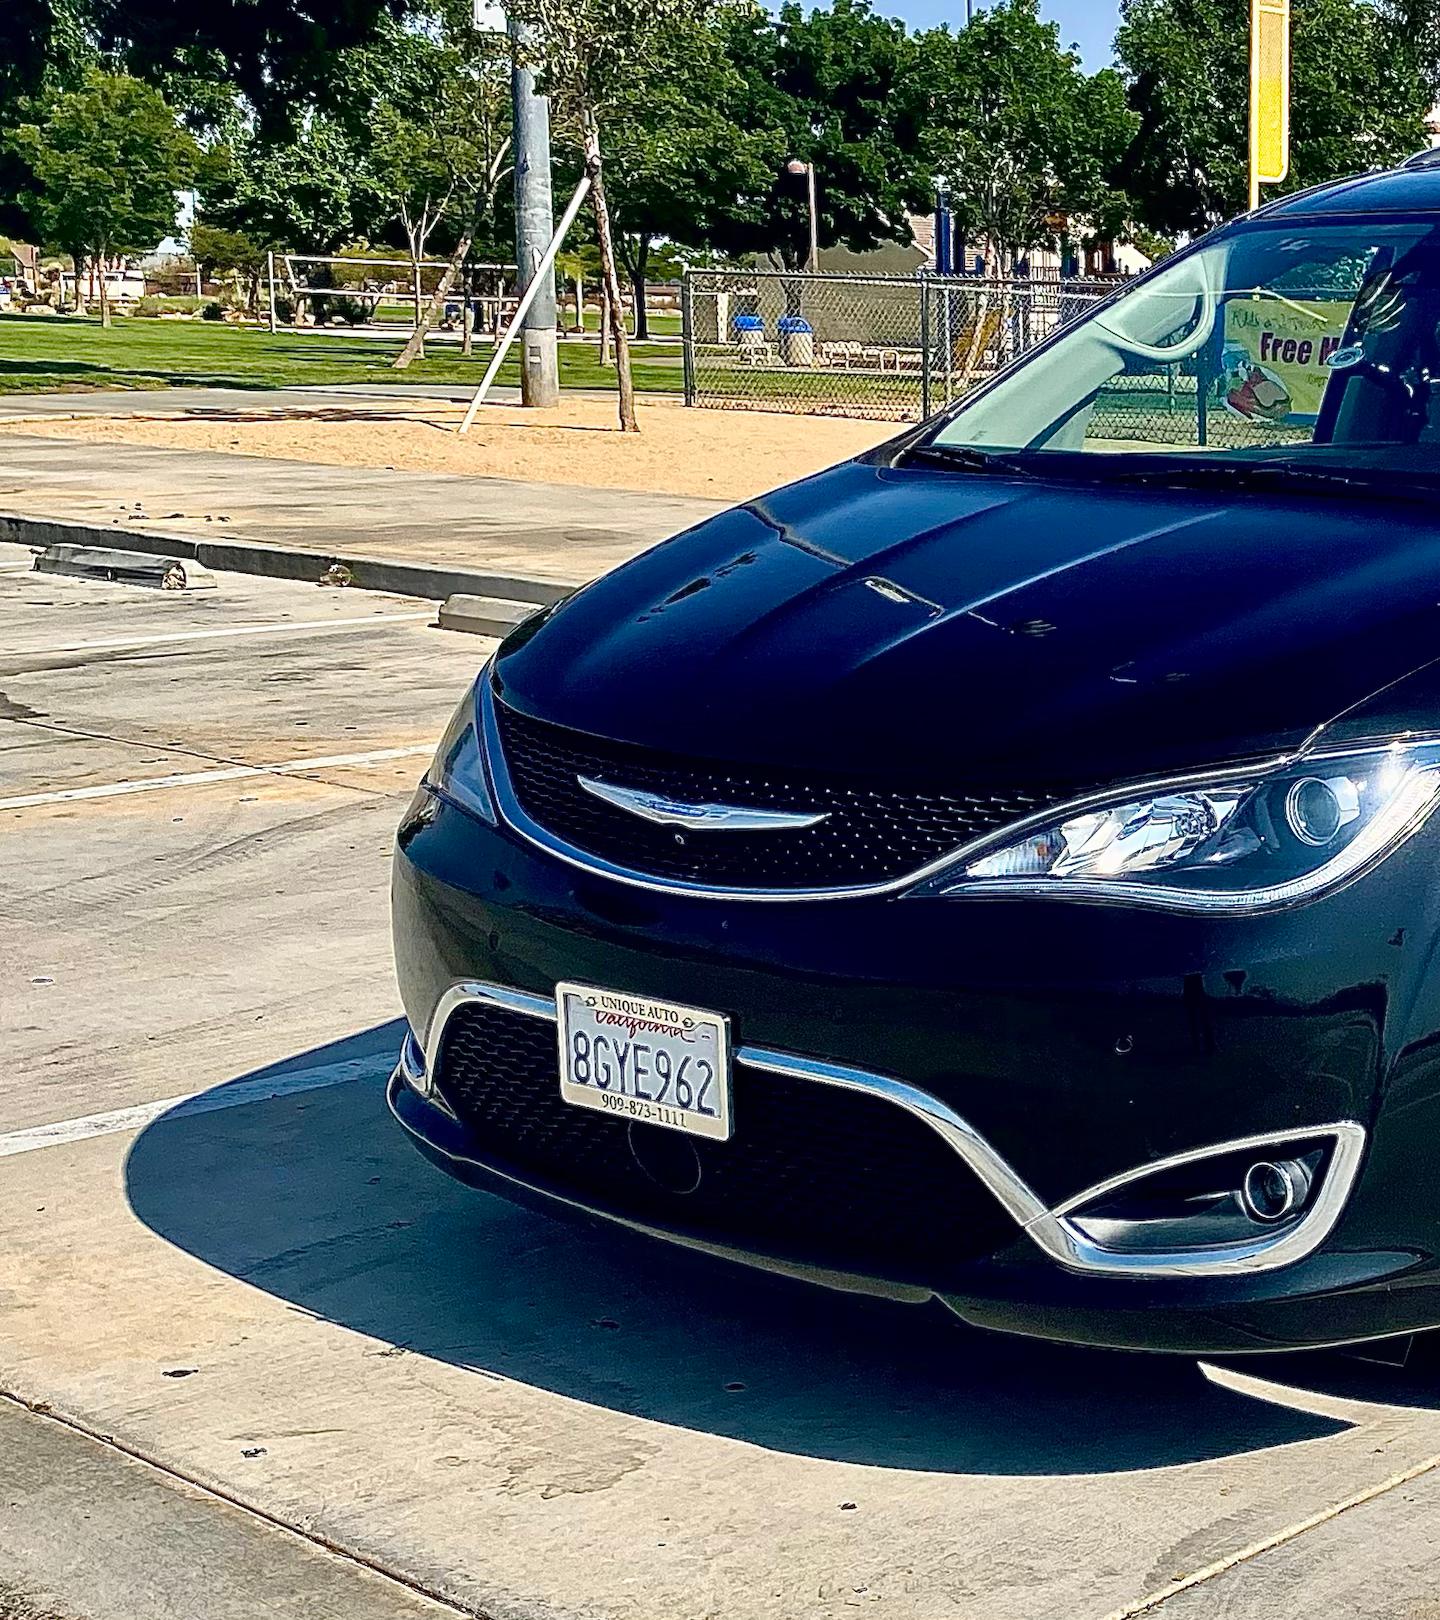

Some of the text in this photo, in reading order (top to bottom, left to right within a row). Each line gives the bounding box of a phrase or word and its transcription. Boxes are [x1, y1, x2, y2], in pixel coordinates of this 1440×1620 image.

[1260, 331, 1313, 365] Free
[600, 995, 679, 1024] UNIQUE AUTO
[573, 1030, 715, 1117] 8GYE962
[601, 1093, 687, 1128] 909-873-1111
